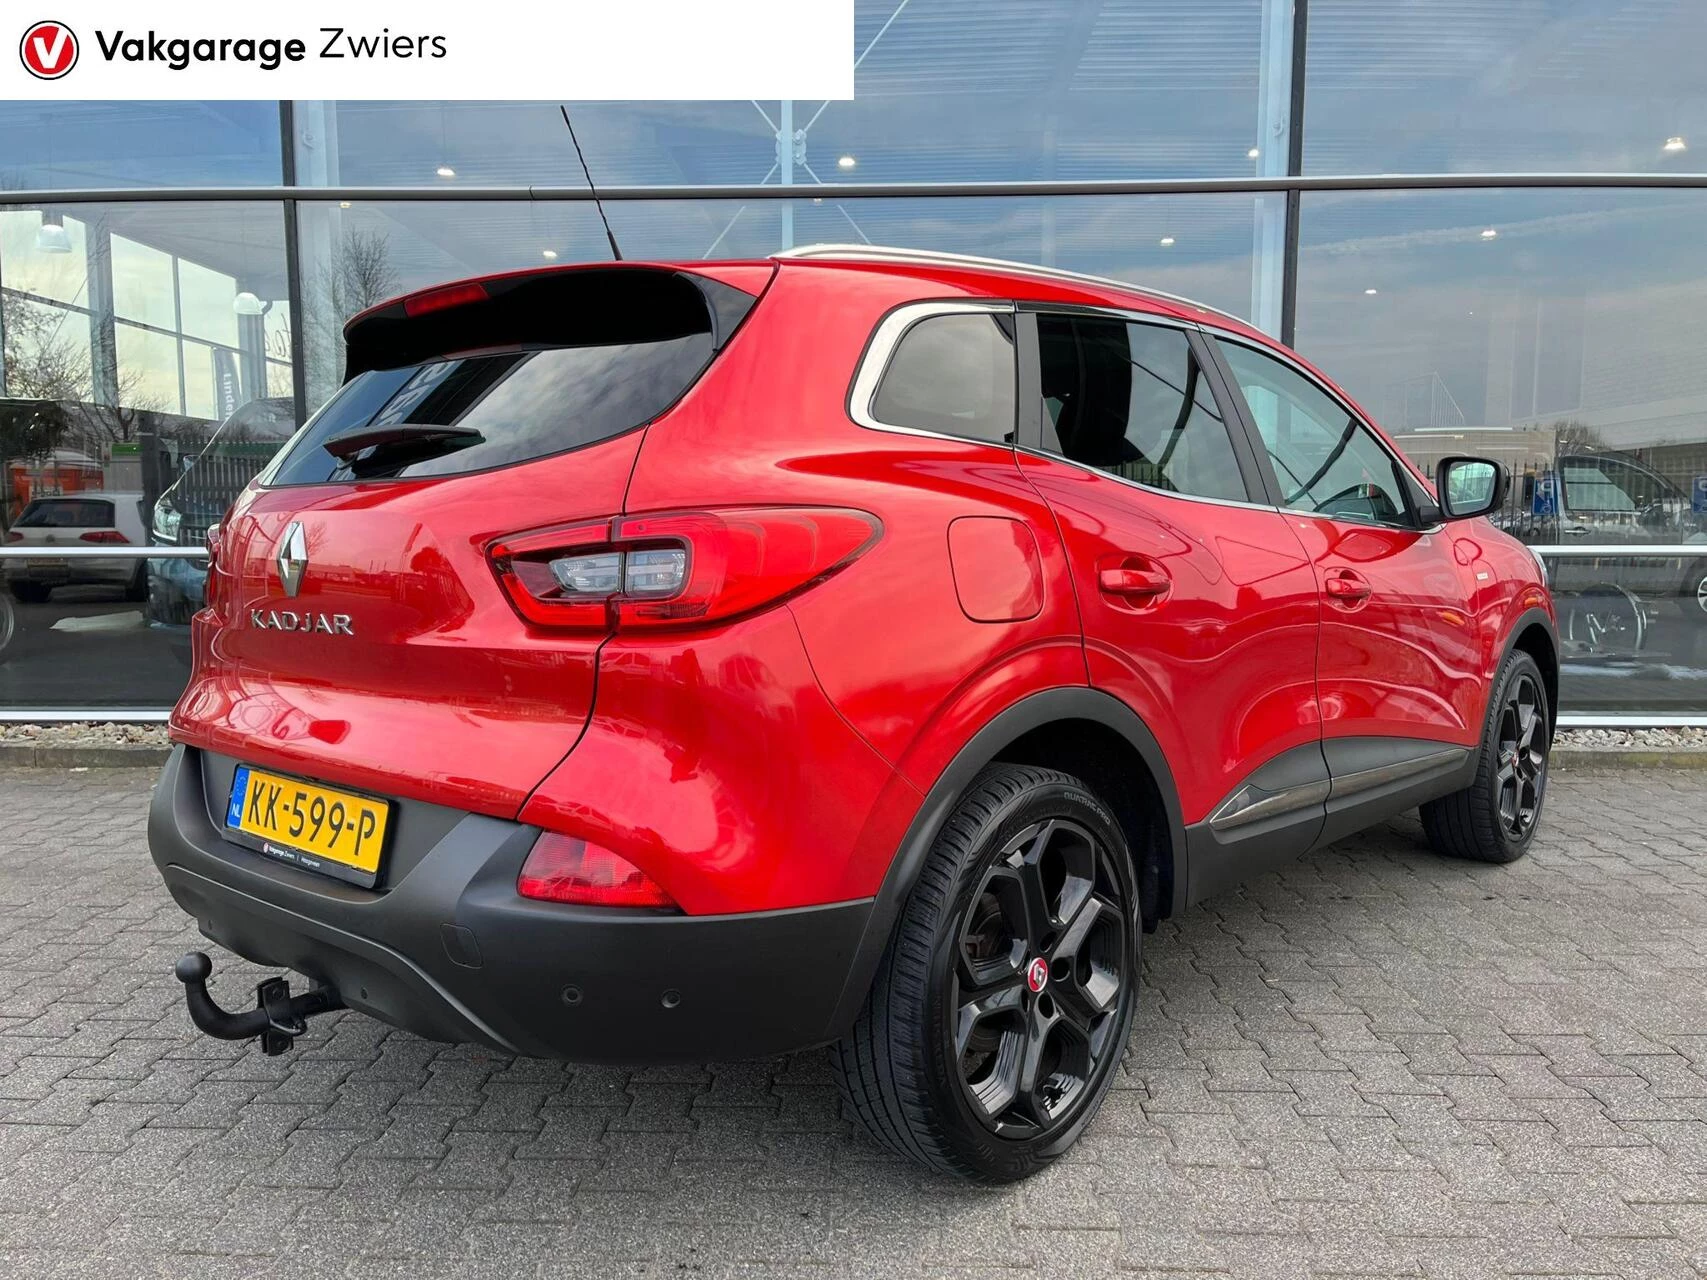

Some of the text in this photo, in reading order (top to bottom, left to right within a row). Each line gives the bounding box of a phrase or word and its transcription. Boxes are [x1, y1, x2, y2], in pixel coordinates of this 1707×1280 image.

[250, 608, 355, 636] KADJAR
[231, 803, 241, 818] NL
[248, 780, 376, 857] KK-599-P
